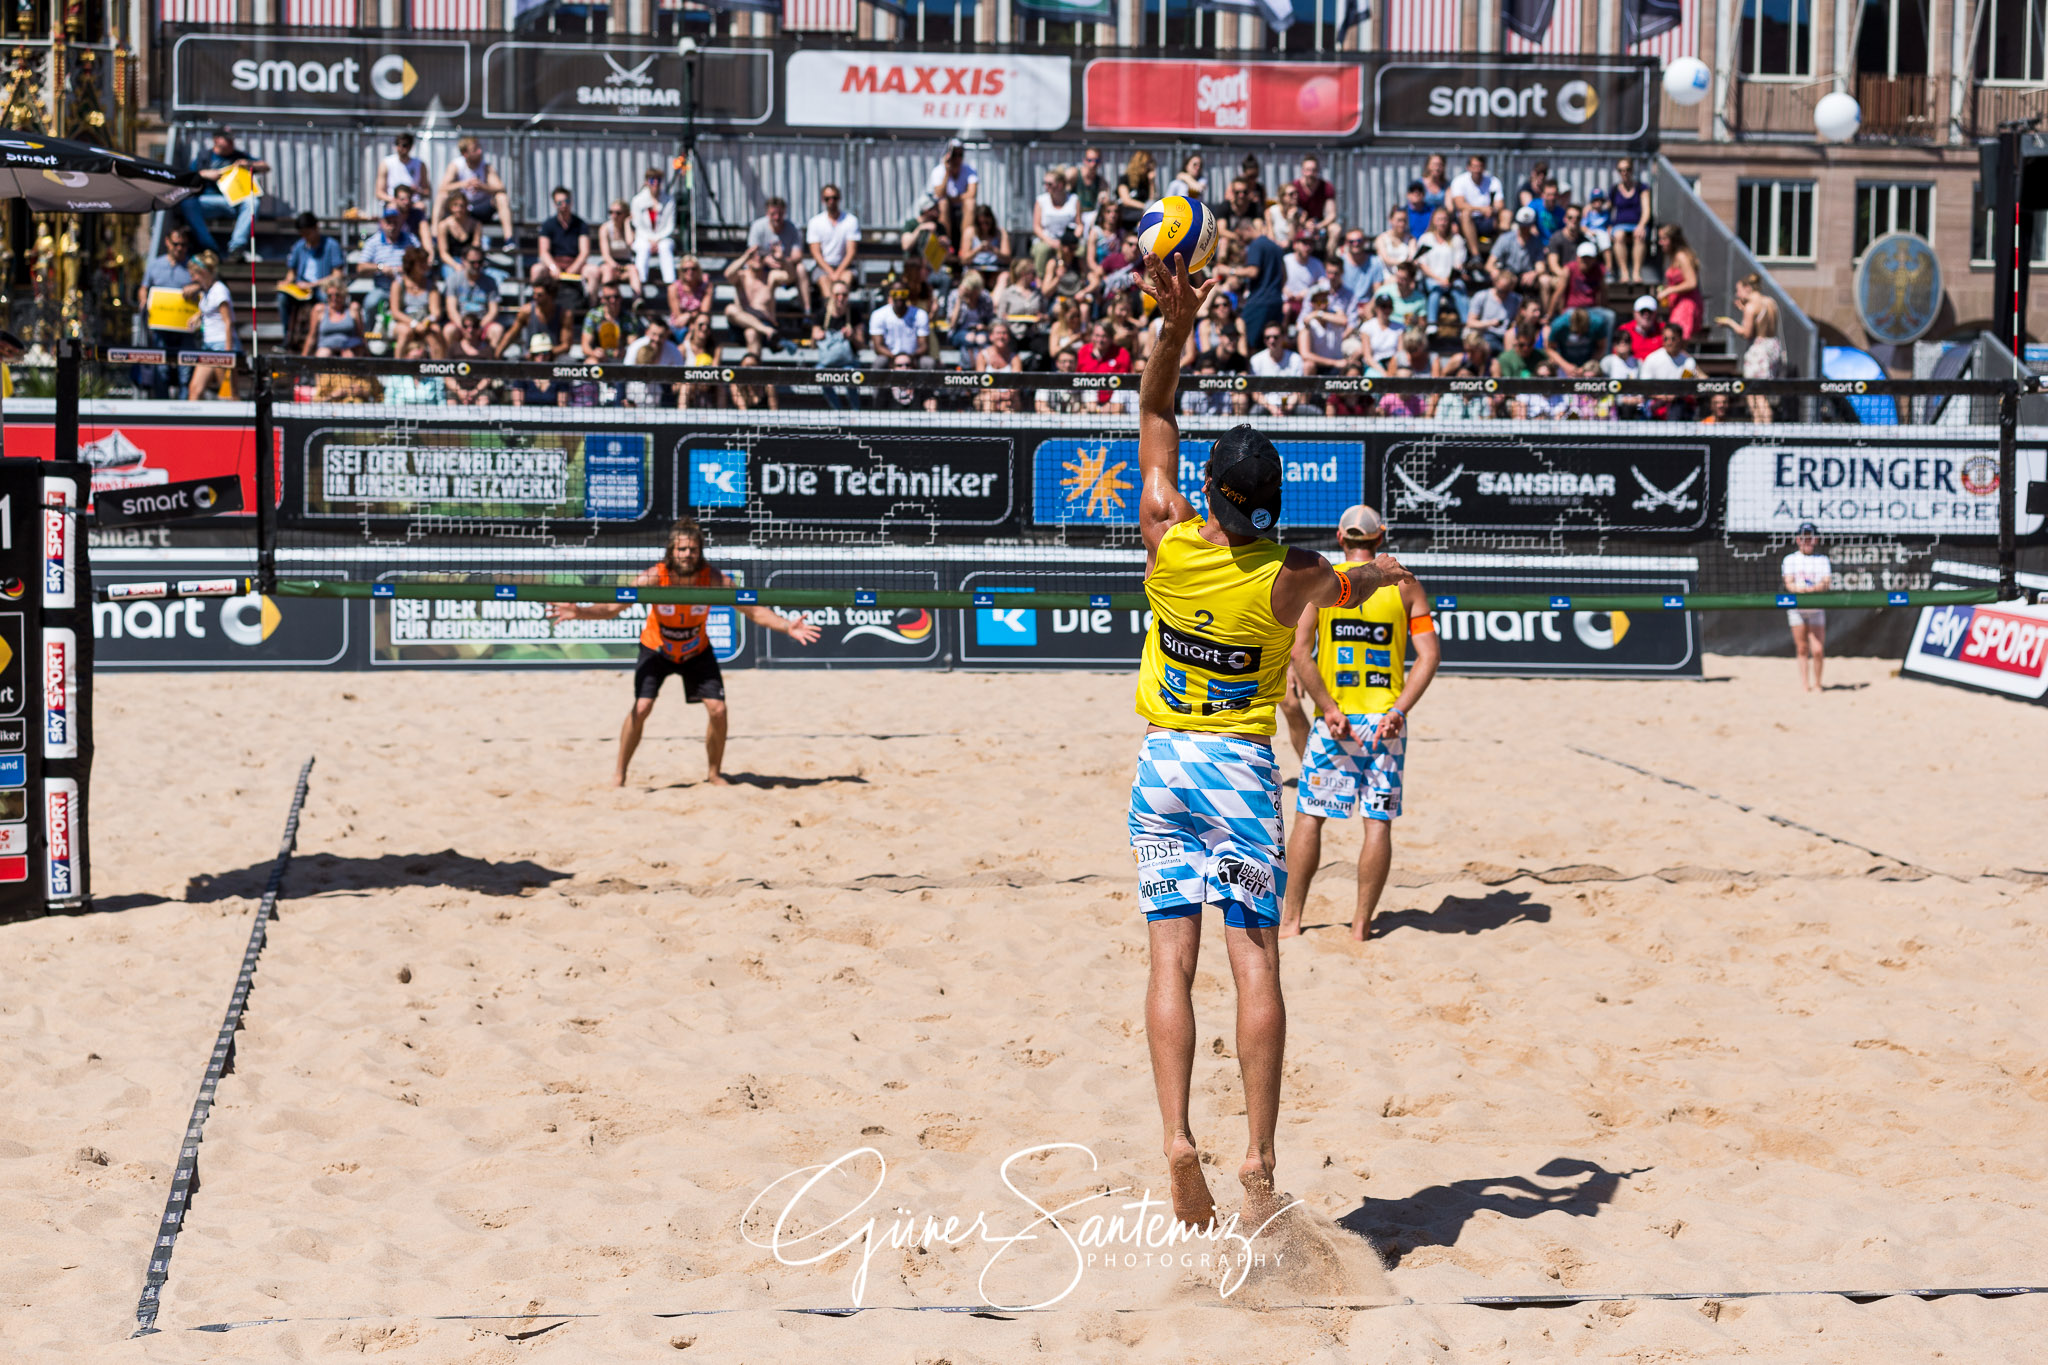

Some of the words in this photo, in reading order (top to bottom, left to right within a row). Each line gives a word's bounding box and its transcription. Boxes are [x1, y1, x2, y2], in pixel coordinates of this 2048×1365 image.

[231, 56, 360, 93] smart
[841, 65, 1006, 96] MAXXIS
[576, 86, 681, 107] SANSIBAR
[1197, 68, 1248, 113] Sport
[1428, 82, 1548, 118] smart
[923, 102, 1008, 119] REIFEN
[6, 152, 59, 166] smart
[419, 362, 456, 375] smart
[552, 365, 589, 378] smart
[684, 369, 720, 381] smart
[815, 372, 851, 384] smart
[944, 374, 980, 387] smart
[1072, 376, 1108, 388] smart
[1199, 377, 1234, 390] smart
[1325, 379, 1359, 391] smart
[1450, 380, 1485, 392] smart
[1574, 380, 1608, 393] smart
[1697, 381, 1731, 393] smart
[1820, 381, 1854, 394] smart
[329, 450, 362, 474] SEI
[367, 451, 409, 475] DER
[1774, 453, 1957, 494] ERDINGER
[329, 474, 349, 495] IN
[354, 475, 448, 497] UNSEREM
[761, 463, 818, 496] Die
[826, 463, 998, 497] Techniker
[1476, 472, 1616, 497] SANSIBAR
[122, 490, 189, 515] smart
[1773, 500, 2000, 521] ALKOHOLFREI
[48, 494, 64, 557] SPOT
[88, 528, 171, 547] smart
[1829, 543, 1908, 565] smart
[48, 561, 65, 593] sky
[1829, 567, 1876, 591] each
[92, 598, 206, 639] mart
[397, 600, 430, 619] SEI
[435, 600, 477, 620] DER
[845, 607, 895, 626] tour
[397, 619, 428, 638] FÜR
[430, 620, 550, 639] DEUTSCHLANDS
[1194, 609, 1215, 636] 2
[1430, 611, 1562, 642] mart
[1925, 606, 1970, 658] sky
[1965, 614, 2048, 668] SPORT
[1163, 632, 1222, 665] smart
[48, 644, 64, 707] SPORT
[1369, 674, 1389, 687] sky
[49, 711, 66, 742] sky
[1307, 797, 1352, 812] DORANTH
[51, 795, 68, 860] SPORT
[1138, 841, 1180, 863] 3DSE
[54, 863, 70, 892] sky
[1239, 874, 1266, 896] ZEIT
[1241, 863, 1271, 886] BEACH
[1141, 879, 1179, 898] HÖFER
